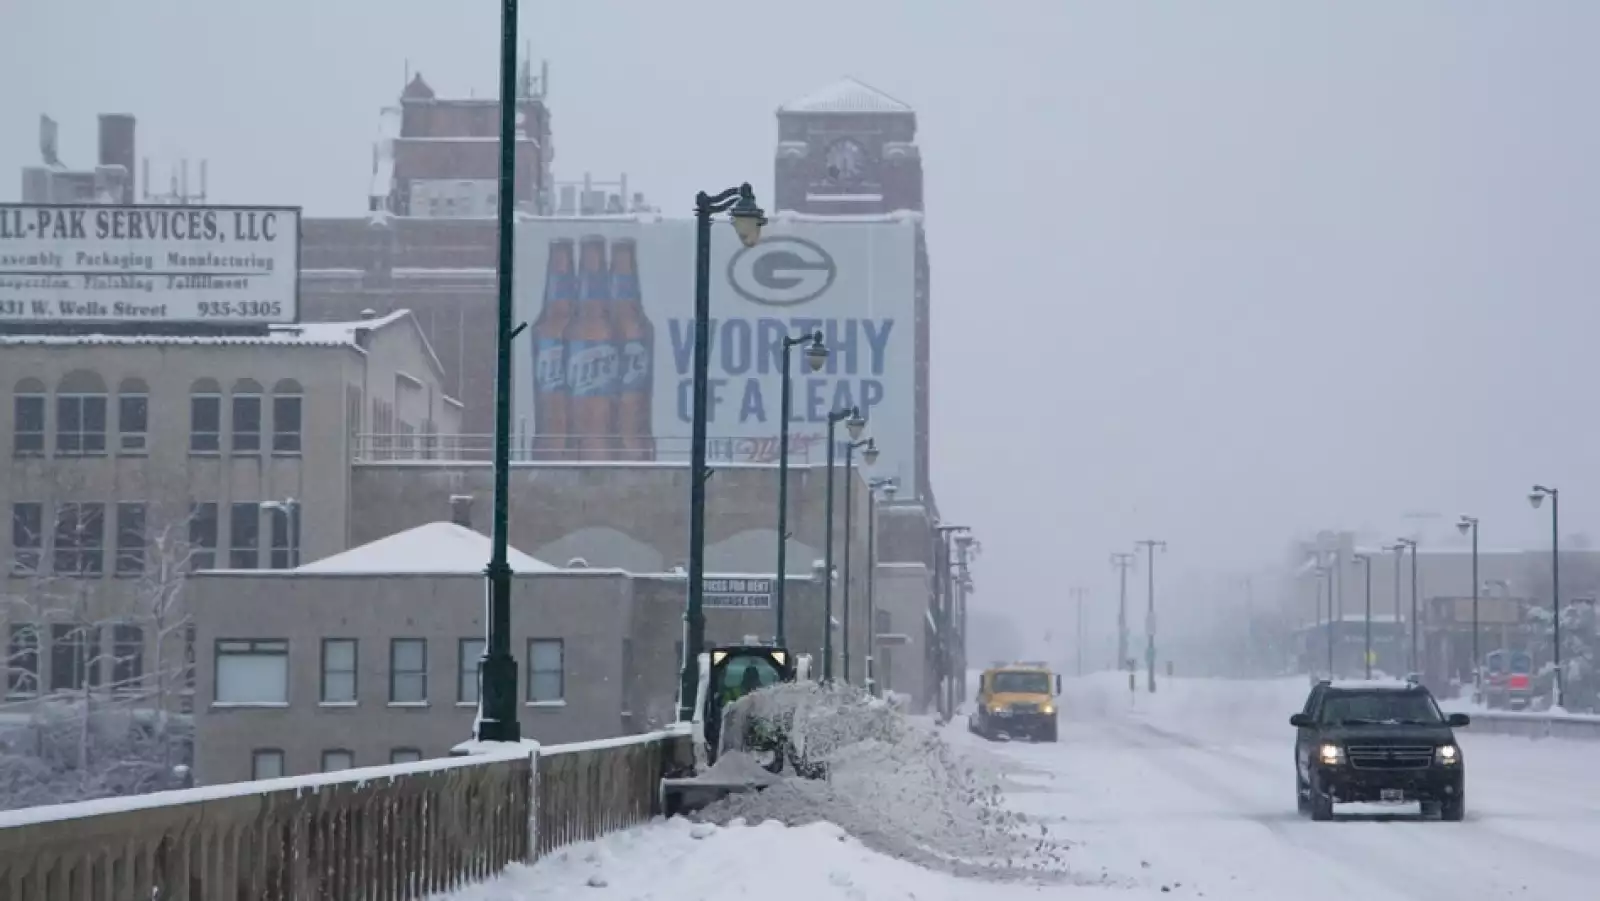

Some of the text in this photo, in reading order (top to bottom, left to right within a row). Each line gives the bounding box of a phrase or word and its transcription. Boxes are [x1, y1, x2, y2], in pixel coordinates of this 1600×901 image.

[95, 210, 225, 243] SERVICES,
[233, 211, 278, 241] LLC
[76, 250, 153, 270] Packaging
[167, 251, 274, 271] Manufacturing
[83, 274, 153, 293] Finishing
[166, 275, 248, 290] Fulfillment
[31, 300, 53, 316] W.
[59, 300, 109, 317] Wells
[113, 301, 167, 317] Street
[197, 301, 281, 317] 935-3305
[667, 318, 894, 375] WORTHY
[677, 377, 884, 423] OF A LEAP
